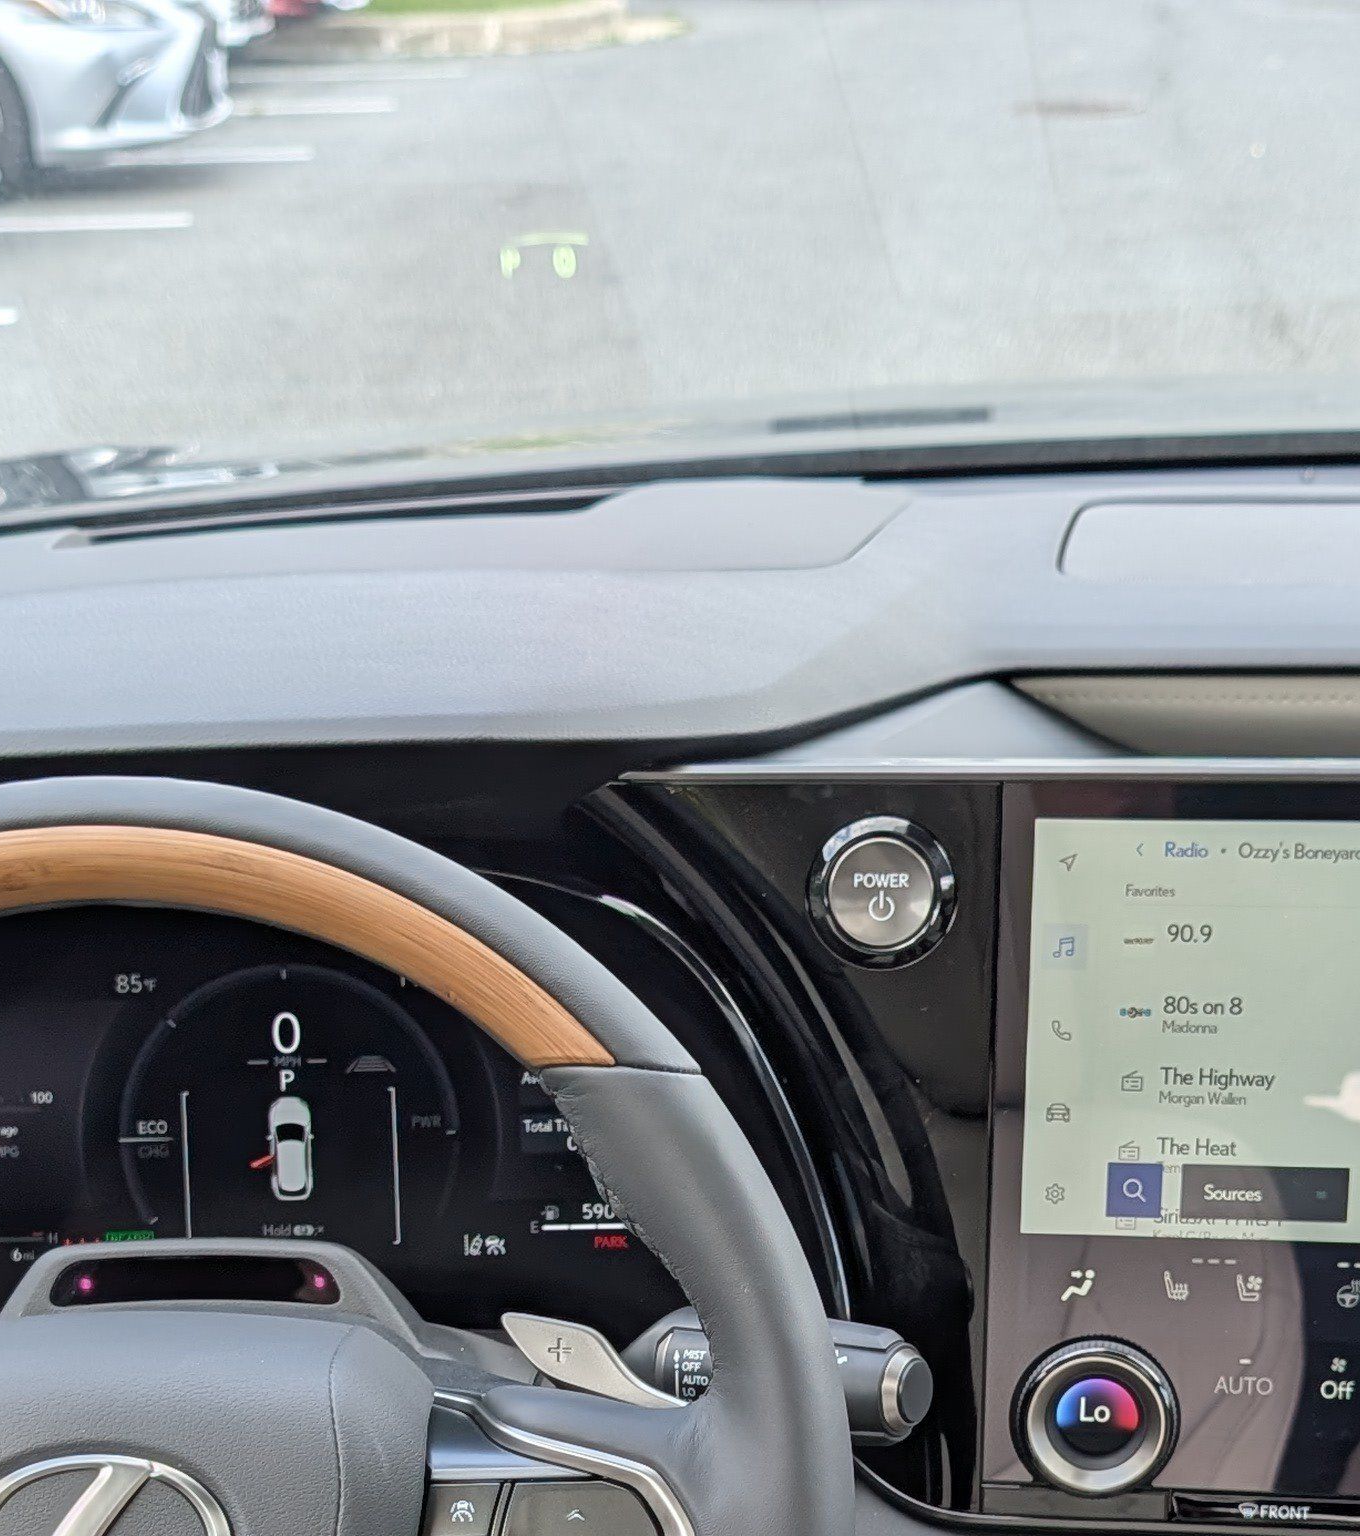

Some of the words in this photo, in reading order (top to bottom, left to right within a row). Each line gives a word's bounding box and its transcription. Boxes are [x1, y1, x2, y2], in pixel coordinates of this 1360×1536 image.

[1164, 841, 1209, 858] Radio
[1238, 842, 1291, 863] Ozzy's
[853, 872, 910, 888] POWER
[1124, 883, 1176, 898] Favorites
[1166, 923, 1214, 944] 90.9
[1163, 996, 1198, 1015] 80s
[1203, 1003, 1225, 1015] on
[1229, 997, 1243, 1016] 8
[271, 1011, 301, 1054] 0
[1161, 1021, 1218, 1035] Madonna
[279, 1069, 296, 1092] P
[1160, 1066, 1193, 1086] The
[1198, 1068, 1276, 1091] Highway
[30, 1090, 54, 1105] 100
[1158, 1092, 1204, 1108] Morgan
[1207, 1093, 1247, 1107] Wallen
[137, 1119, 168, 1135] ECO
[522, 1118, 553, 1133] Total
[1156, 1137, 1190, 1156] The
[1195, 1138, 1237, 1157] Heat
[1203, 1183, 1263, 1203] Sources
[681, 1362, 702, 1373] OFF
[682, 1374, 709, 1387] AUTO
[1213, 1375, 1274, 1397] AUTO
[1320, 1379, 1356, 1401] Off
[1077, 1396, 1111, 1425] Lo
[1259, 1505, 1311, 1521] FRONT
